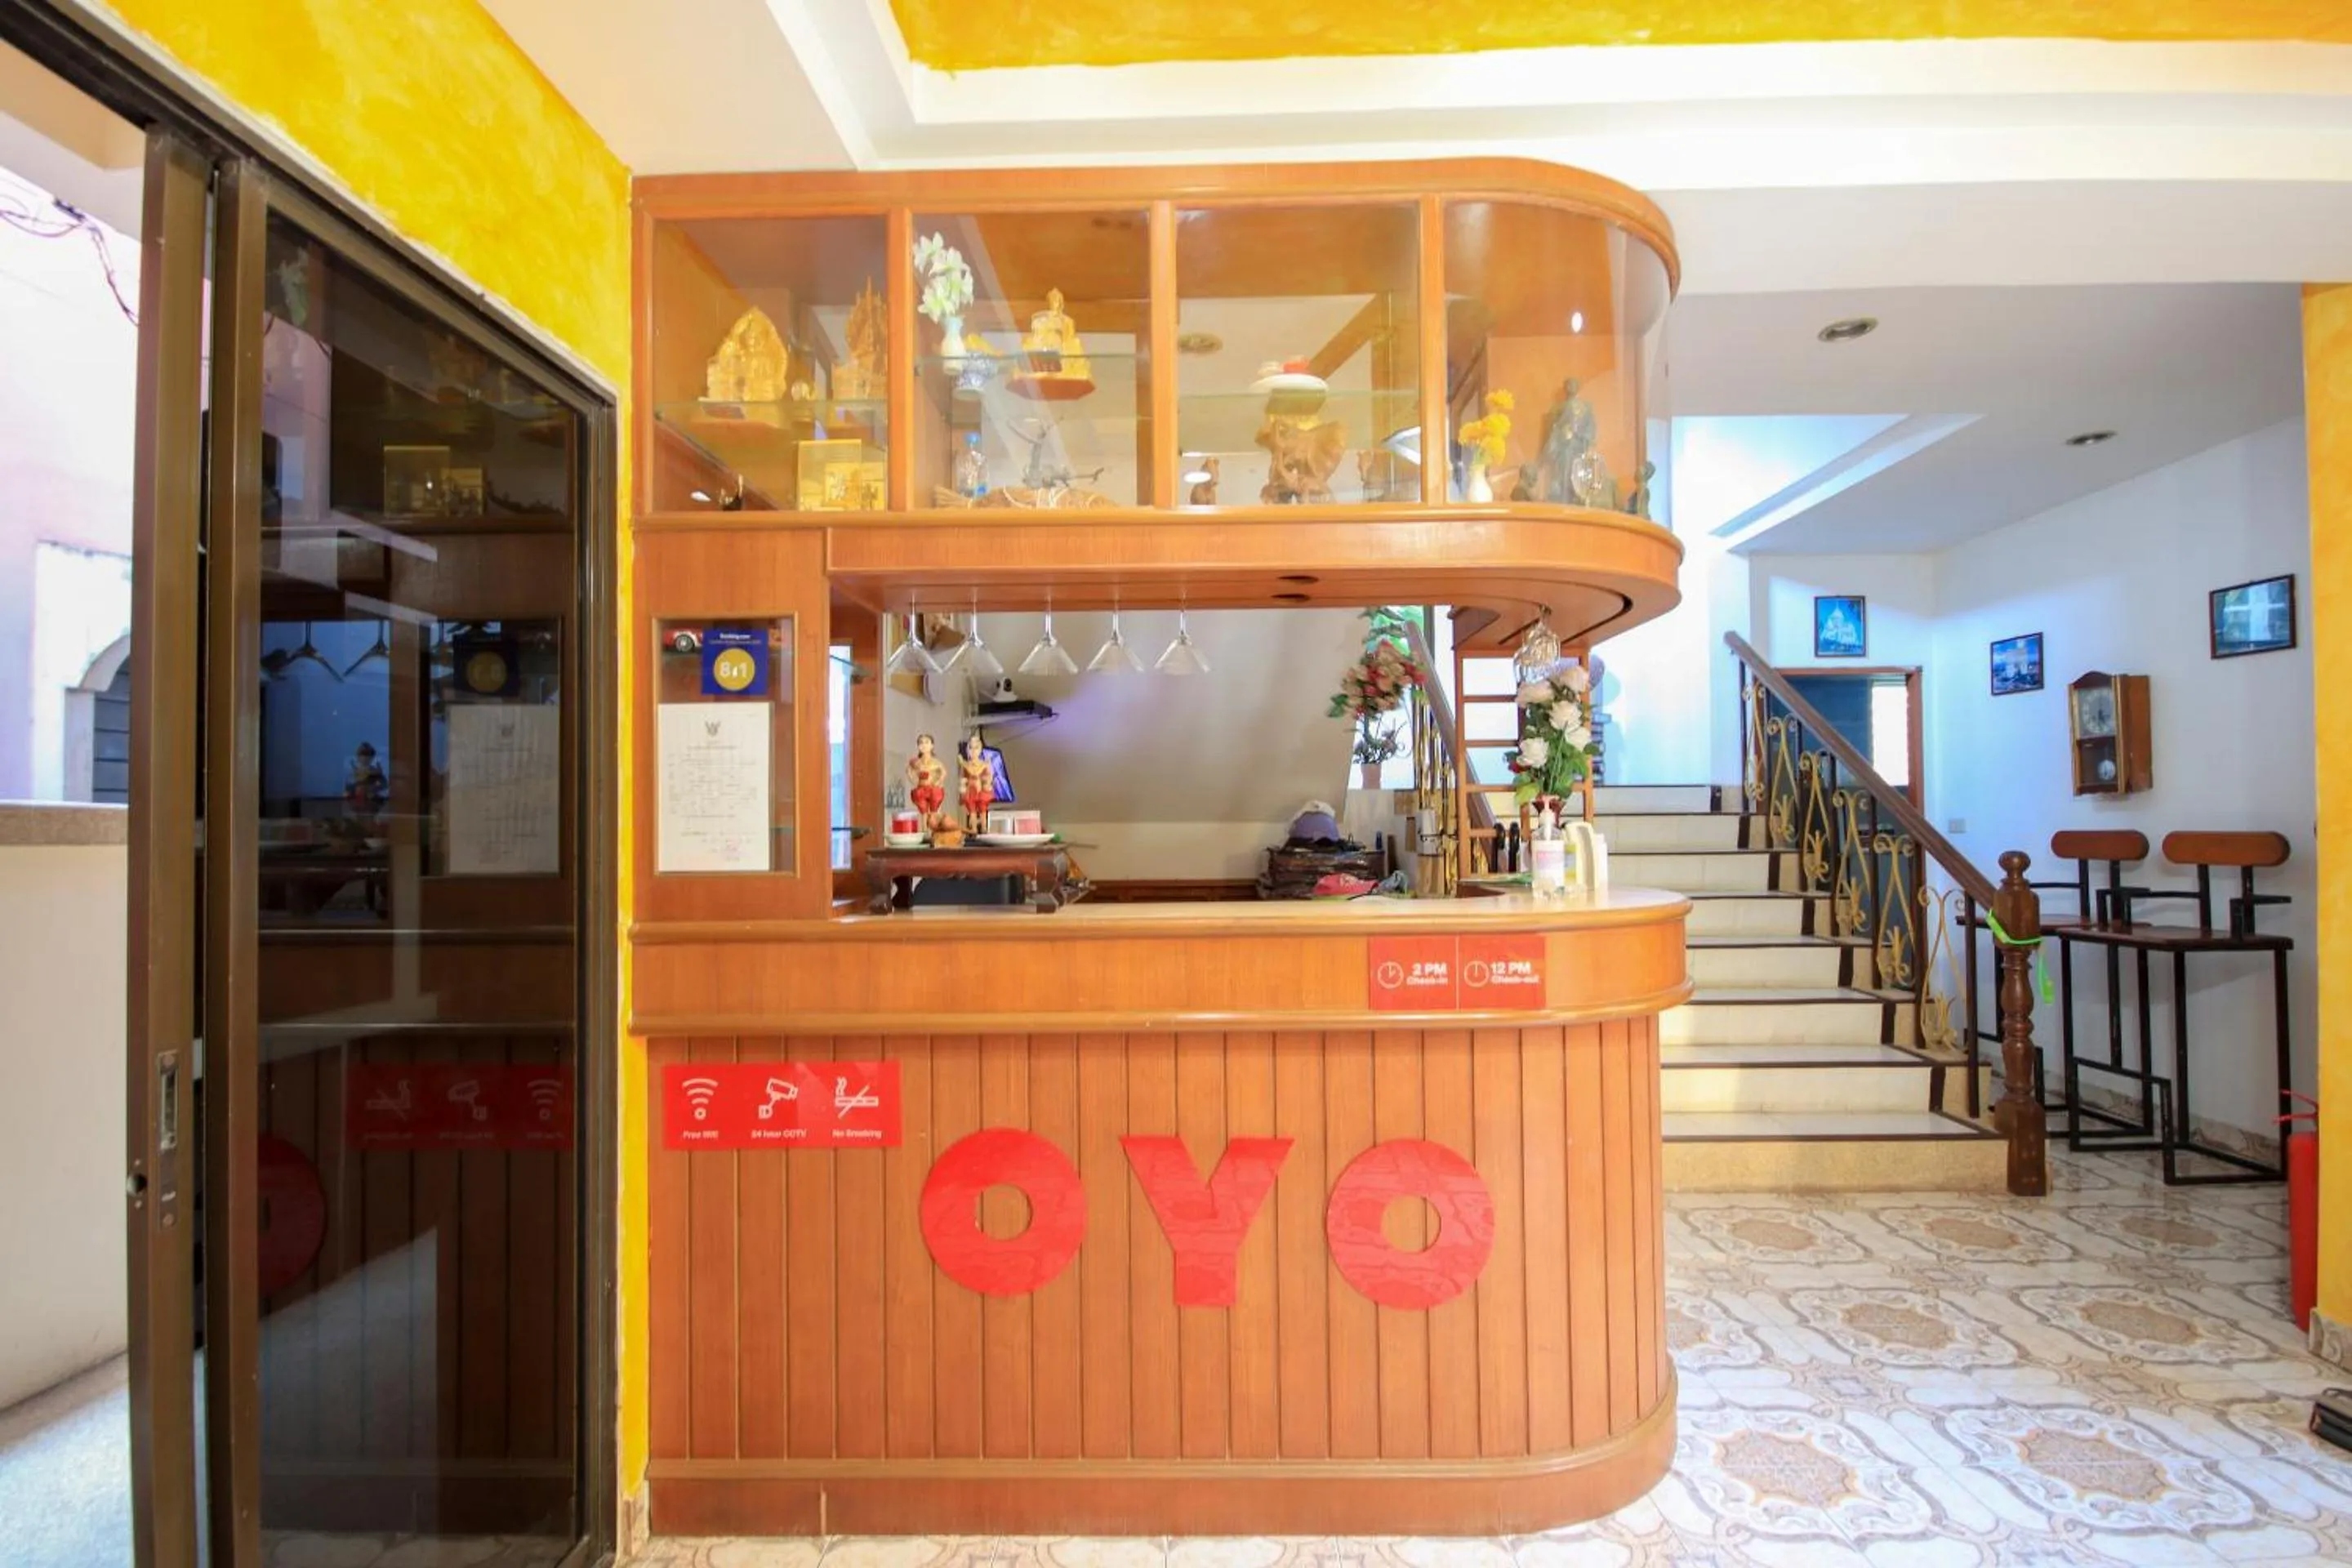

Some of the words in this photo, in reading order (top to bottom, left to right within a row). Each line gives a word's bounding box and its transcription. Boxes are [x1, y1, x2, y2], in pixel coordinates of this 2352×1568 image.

[1412, 962, 1422, 976] 2
[1424, 962, 1447, 976] PM
[1490, 961, 1506, 974] 12
[1508, 961, 1531, 974] PM
[919, 1127, 1494, 1311] OYO
